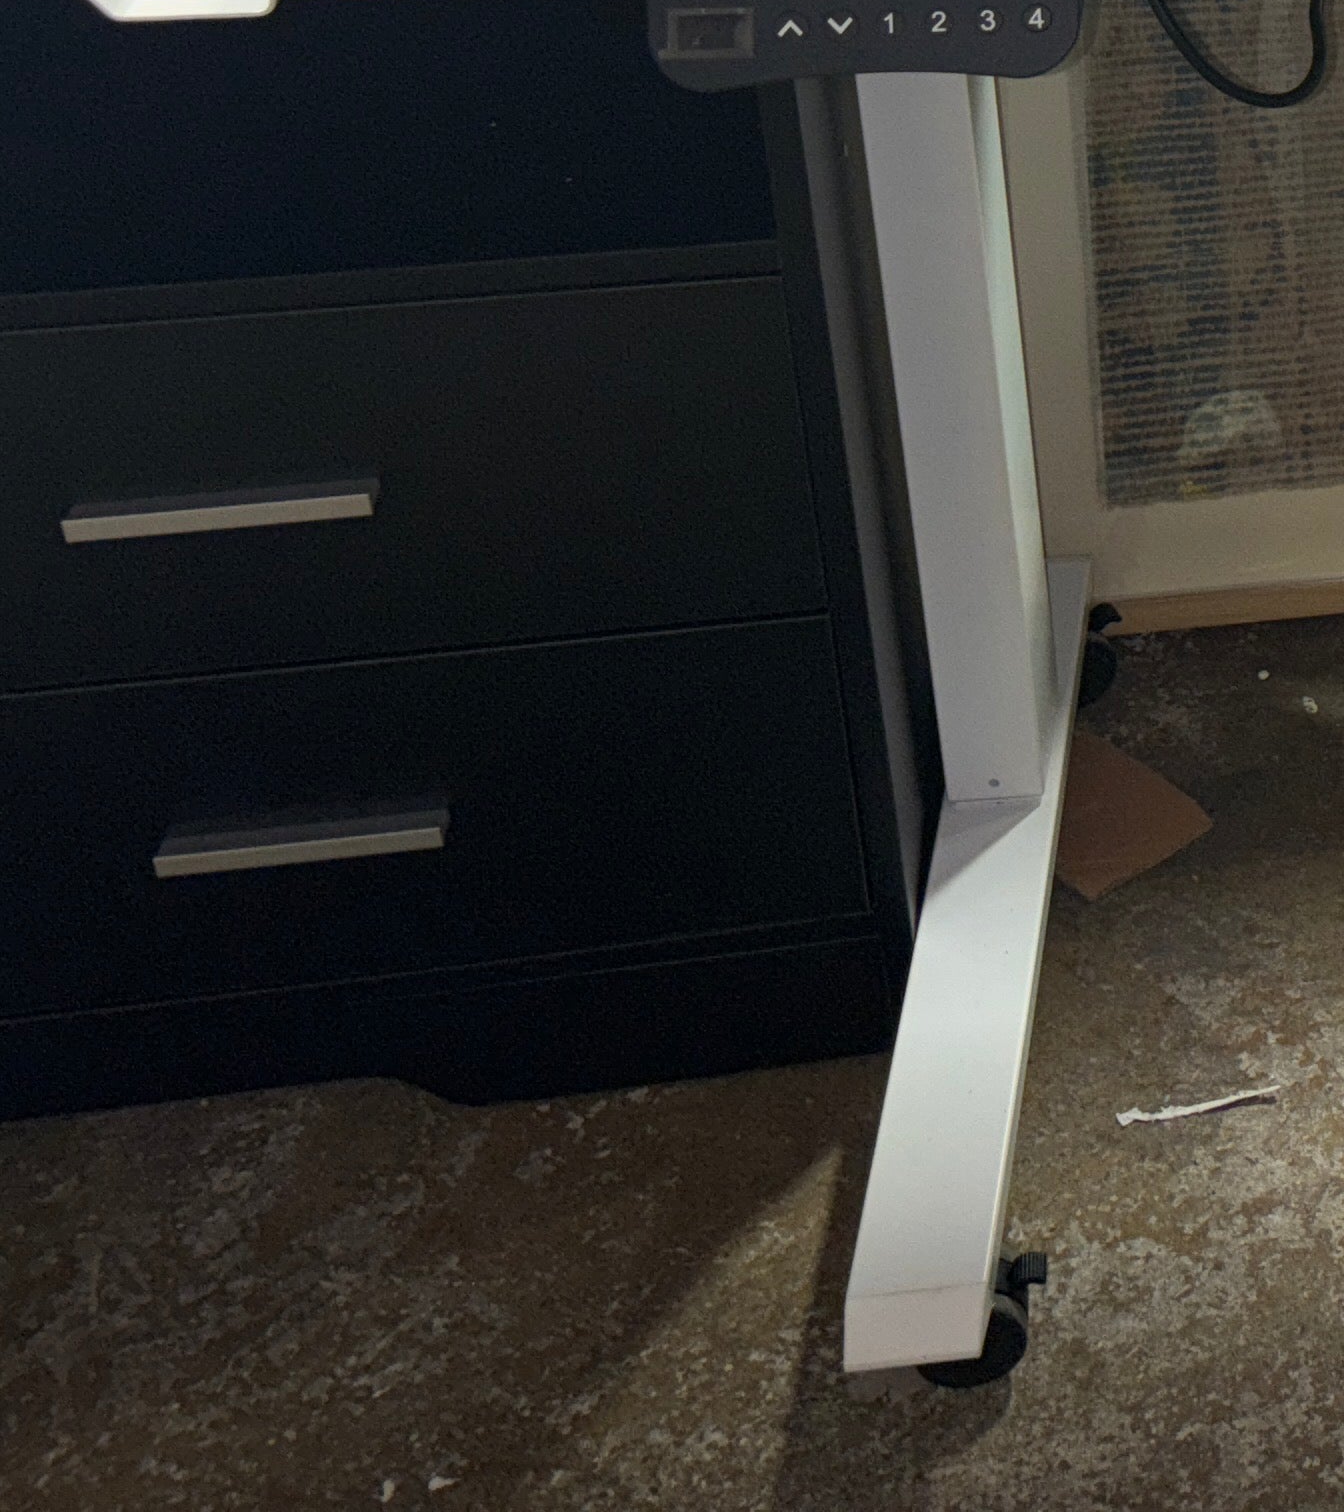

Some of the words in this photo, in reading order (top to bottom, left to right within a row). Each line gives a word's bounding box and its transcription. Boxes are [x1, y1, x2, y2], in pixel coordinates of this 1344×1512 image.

[883, 13, 896, 34] 1
[931, 11, 947, 33] 2
[980, 10, 996, 32] 3
[1028, 8, 1046, 30] 4
